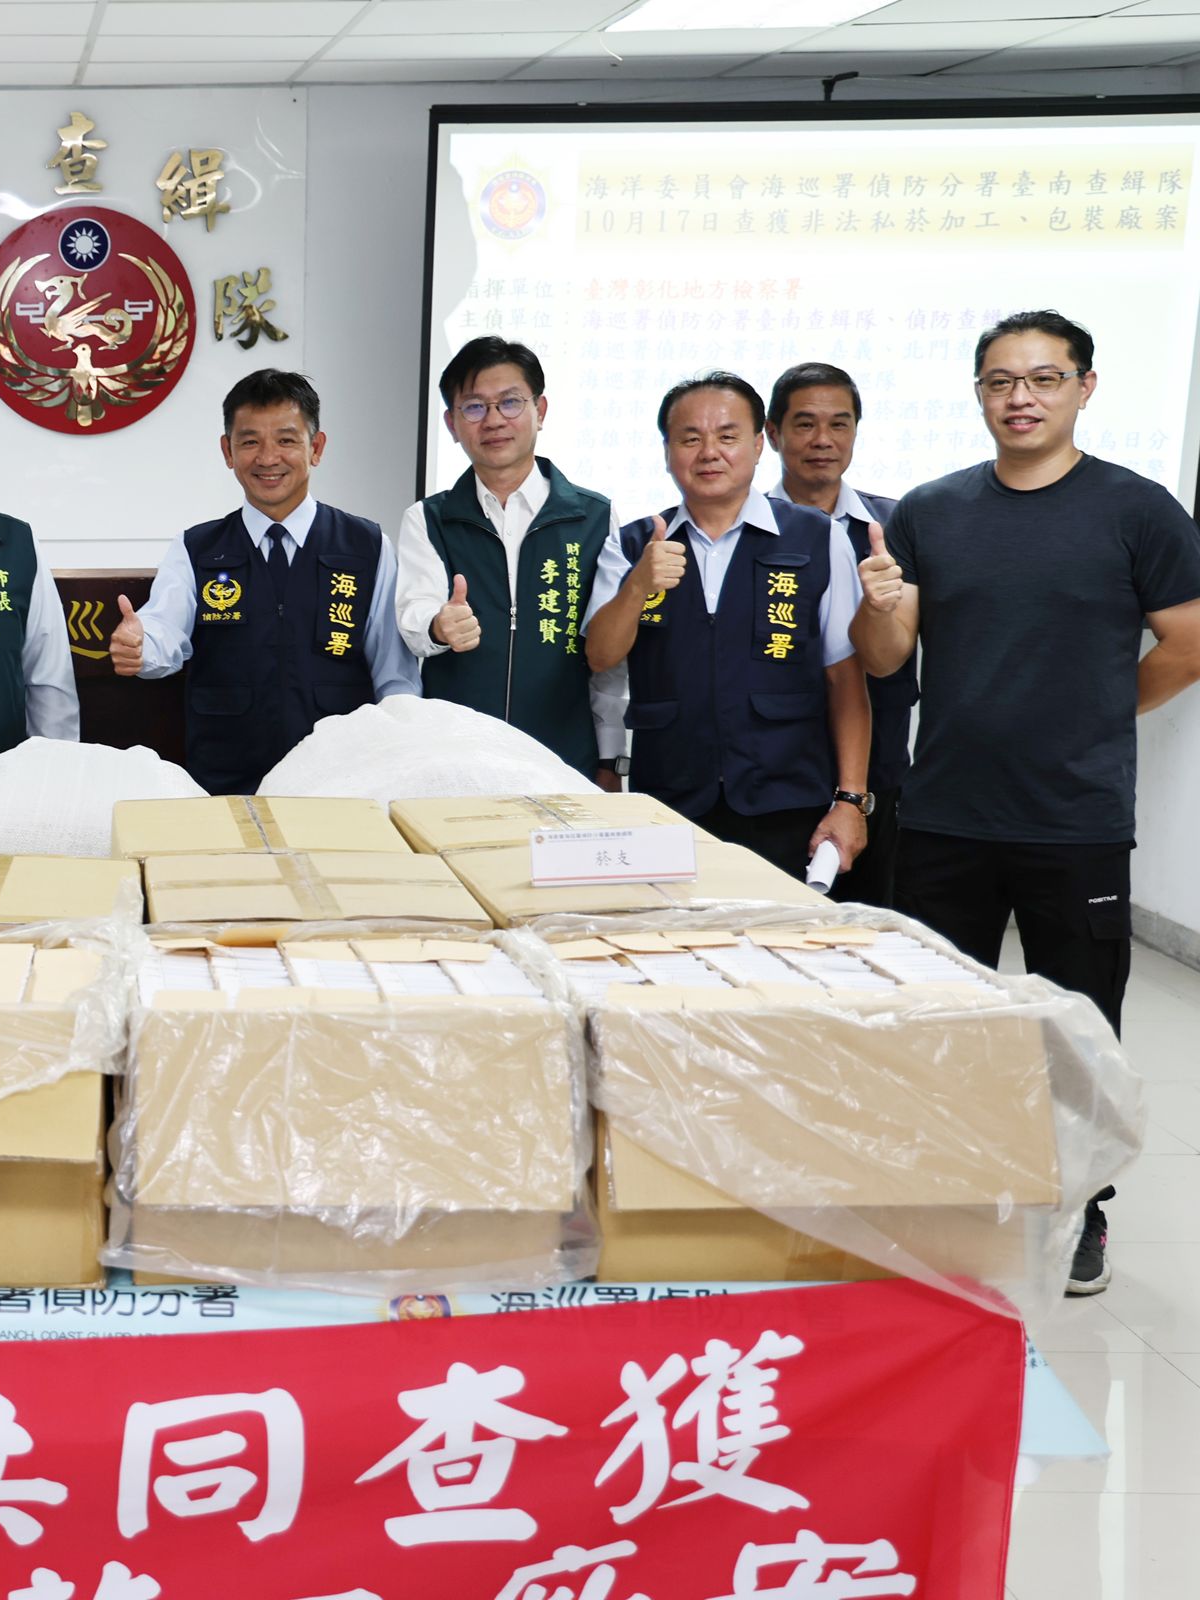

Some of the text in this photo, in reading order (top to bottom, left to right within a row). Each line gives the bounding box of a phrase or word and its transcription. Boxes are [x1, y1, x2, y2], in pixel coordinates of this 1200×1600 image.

[583, 167, 1185, 201] 海洋委員會海巡署偵防分署臺南查緝隊
[202, 611, 242, 622] 偵防分署
[325, 573, 357, 656] 海巡署
[538, 558, 563, 645] 李建賢
[564, 543, 581, 655] 財政稅務局局長
[764, 572, 799, 659] 海巡署
[595, 850, 632, 866] 菸支
